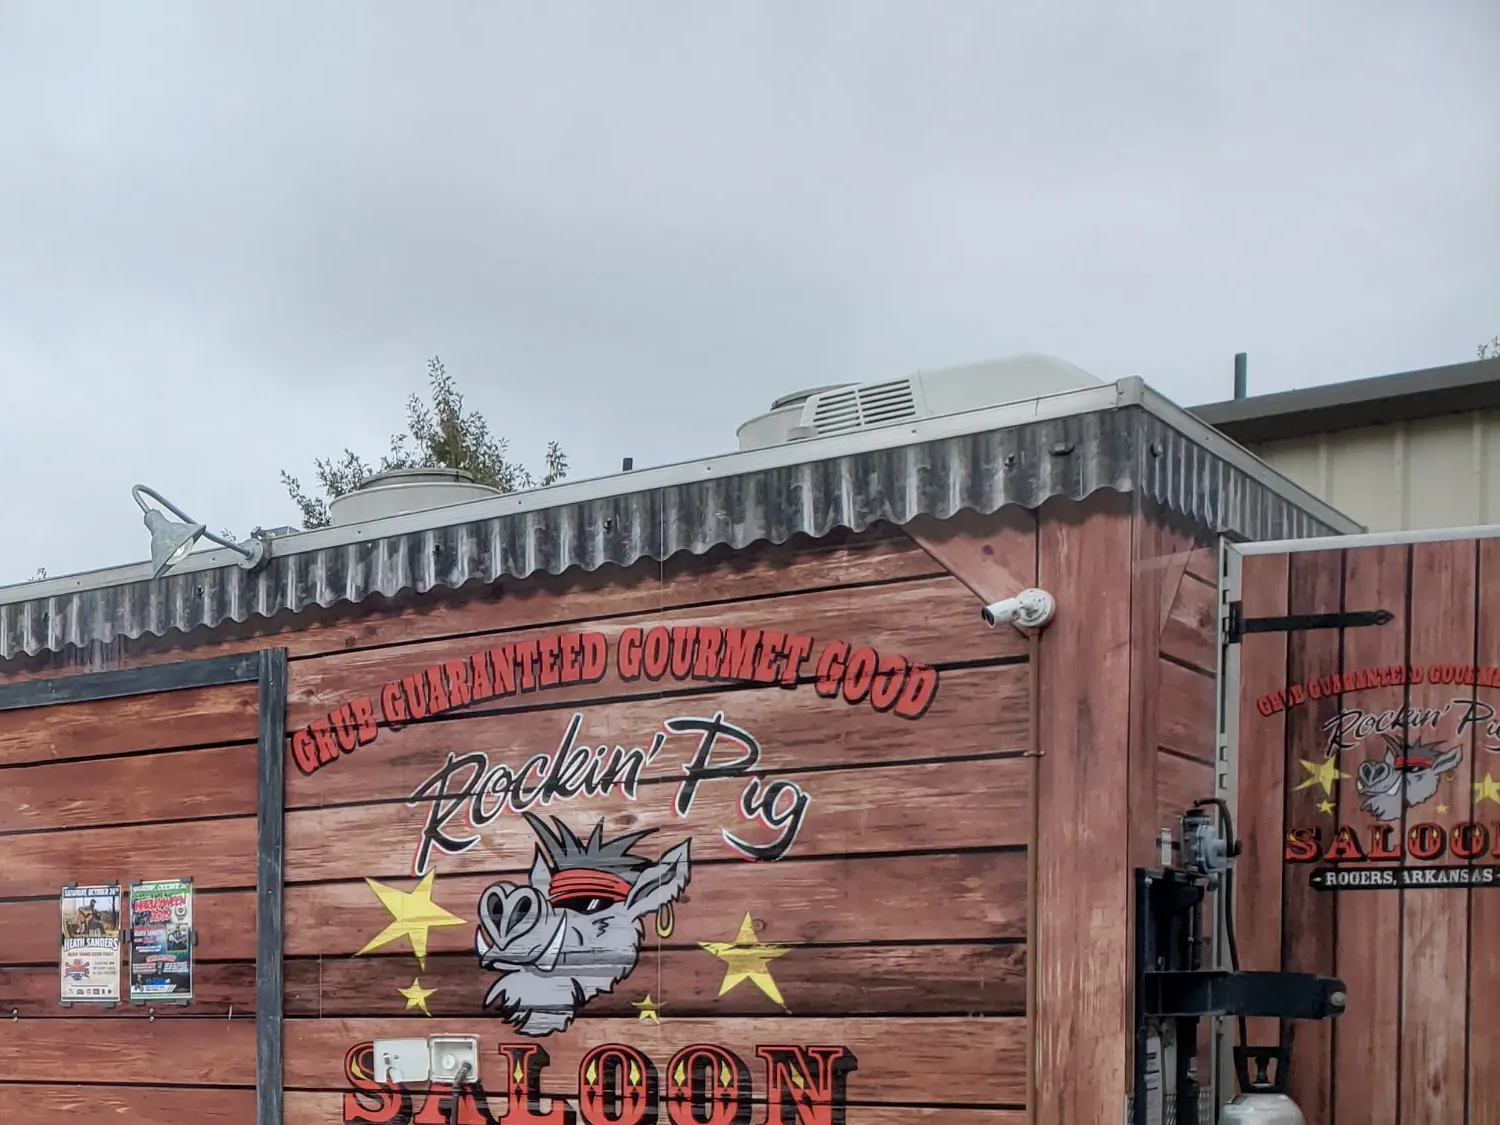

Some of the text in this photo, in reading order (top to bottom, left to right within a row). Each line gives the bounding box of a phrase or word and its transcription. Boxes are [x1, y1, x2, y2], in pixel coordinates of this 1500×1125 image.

[291, 626, 940, 776] GRUB GUARANTEED GOURMET GOOD
[407, 710, 811, 876] Rockin' Pig
[1285, 821, 1500, 863] SALOO
[1402, 868, 1494, 885] ARKANSAS
[64, 938, 118, 951] HEATH SANDERS
